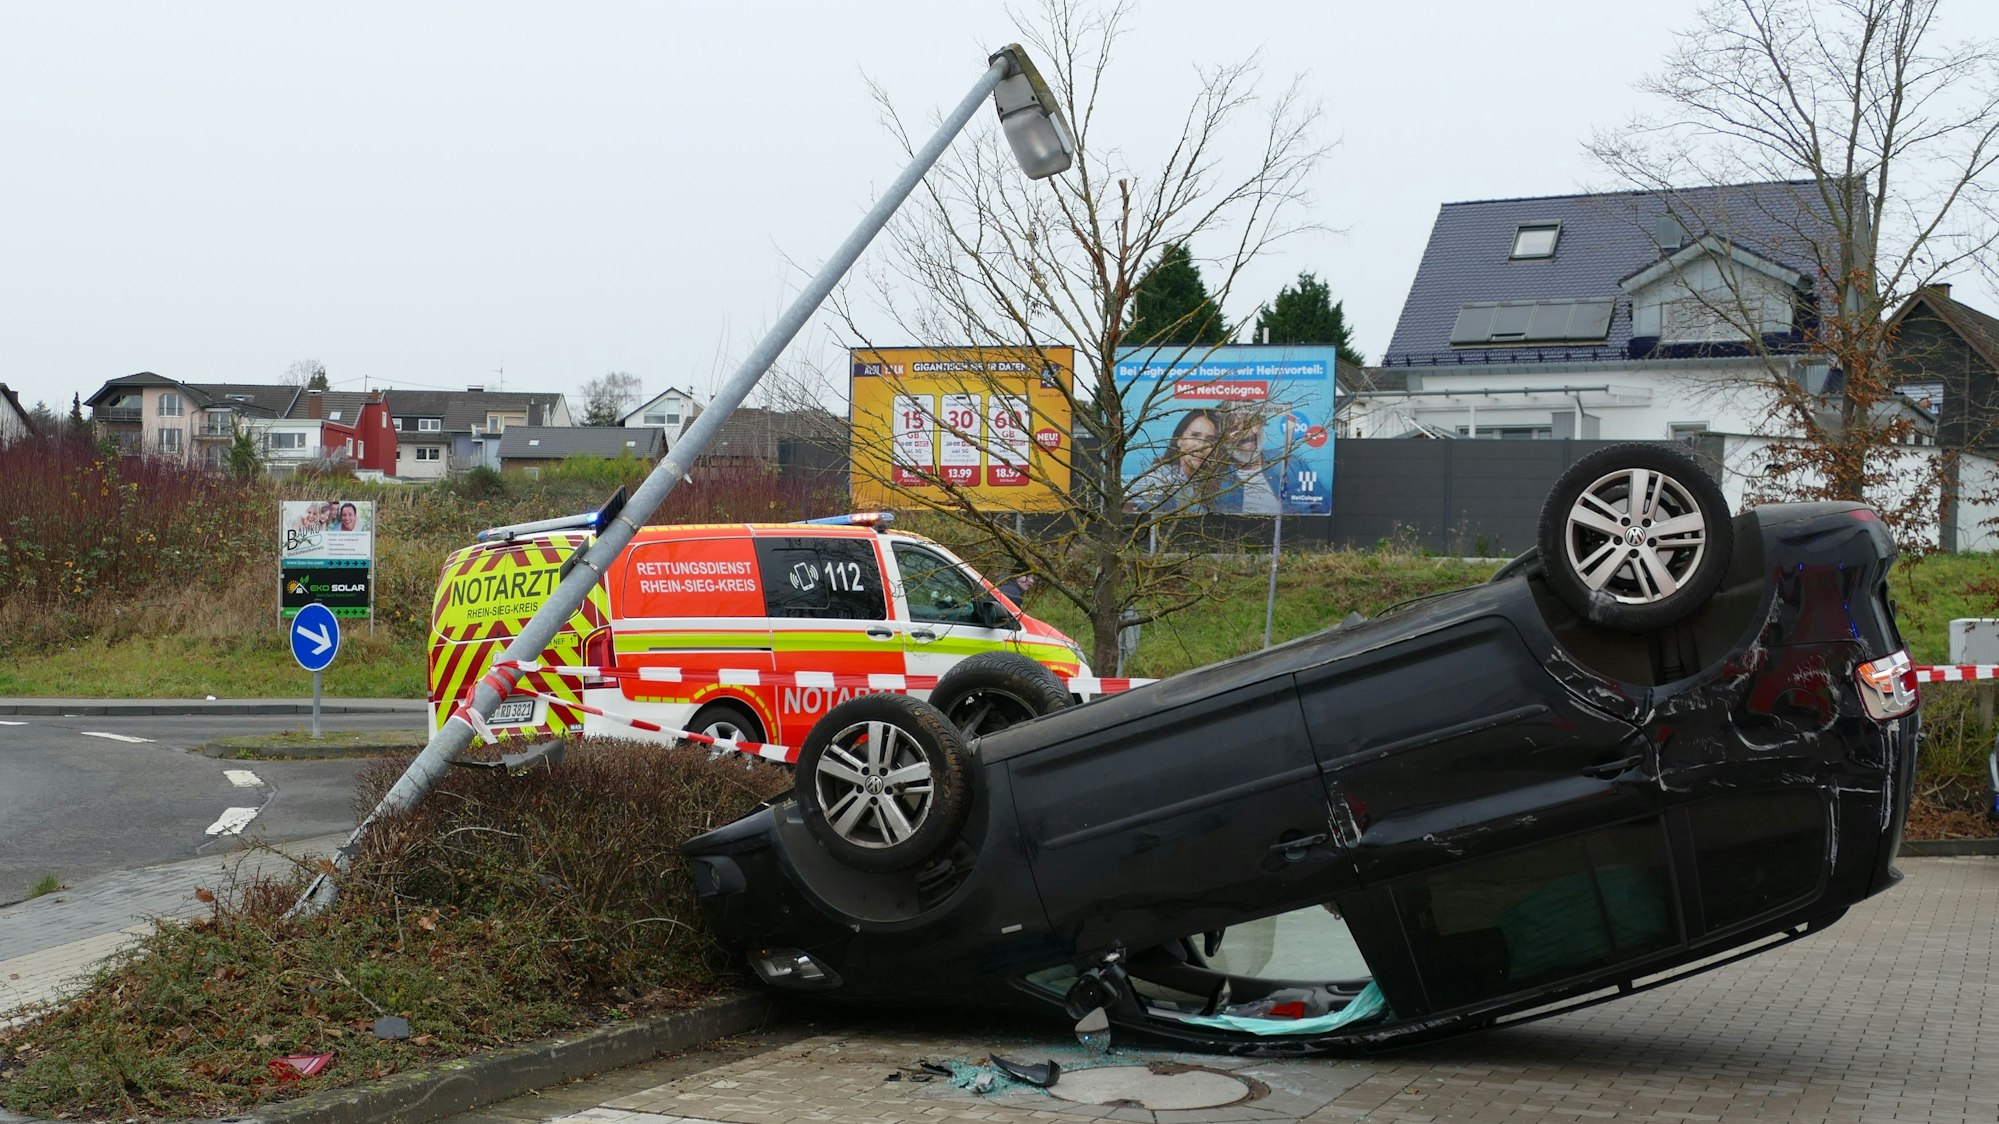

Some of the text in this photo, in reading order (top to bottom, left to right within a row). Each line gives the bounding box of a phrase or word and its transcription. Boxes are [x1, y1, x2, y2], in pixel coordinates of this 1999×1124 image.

[1120, 366, 1137, 376] Bei
[1237, 365, 1254, 375] wir
[1177, 384, 1195, 394] Mit
[902, 410, 924, 429] 15
[948, 410, 973, 429] 30
[1282, 422, 1308, 432] 100
[1036, 432, 1059, 441] NEU!
[947, 468, 972, 478] 13.99
[636, 561, 752, 576] RETTUNGSDIENST
[824, 561, 865, 592] 112
[309, 584, 365, 592] EKO SOLAR
[451, 568, 559, 608] NOTARZT
[640, 578, 756, 594] RHEIN-SIEG-KREIS
[466, 601, 539, 619] RHEIN-SIEG-KREIS
[784, 686, 896, 715] NOTA
[501, 704, 512, 718] RD
[511, 703, 531, 717] 3821
